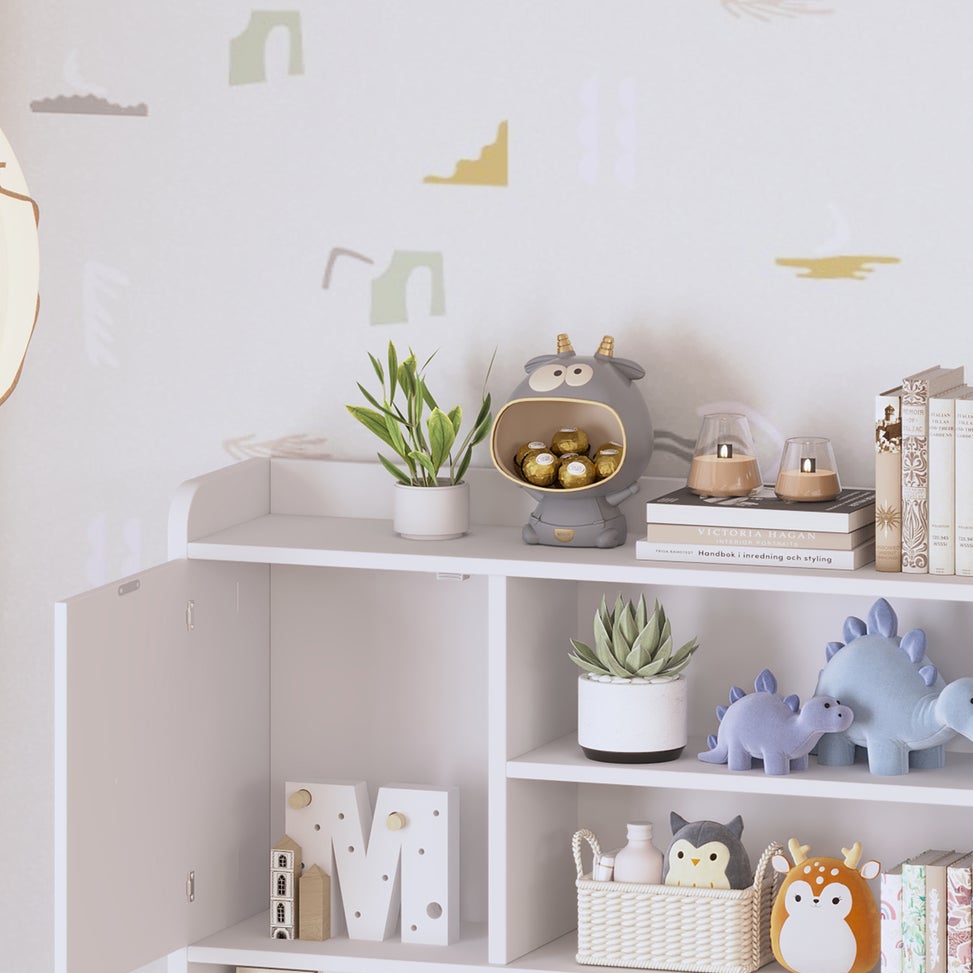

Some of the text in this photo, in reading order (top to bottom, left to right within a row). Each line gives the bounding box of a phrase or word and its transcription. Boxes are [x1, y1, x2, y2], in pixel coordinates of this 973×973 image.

[697, 528, 817, 540] VICTORIA HAGAN
[698, 550, 736, 559] Handbok
[743, 551, 784, 562] inredning
[804, 554, 833, 565] styling
